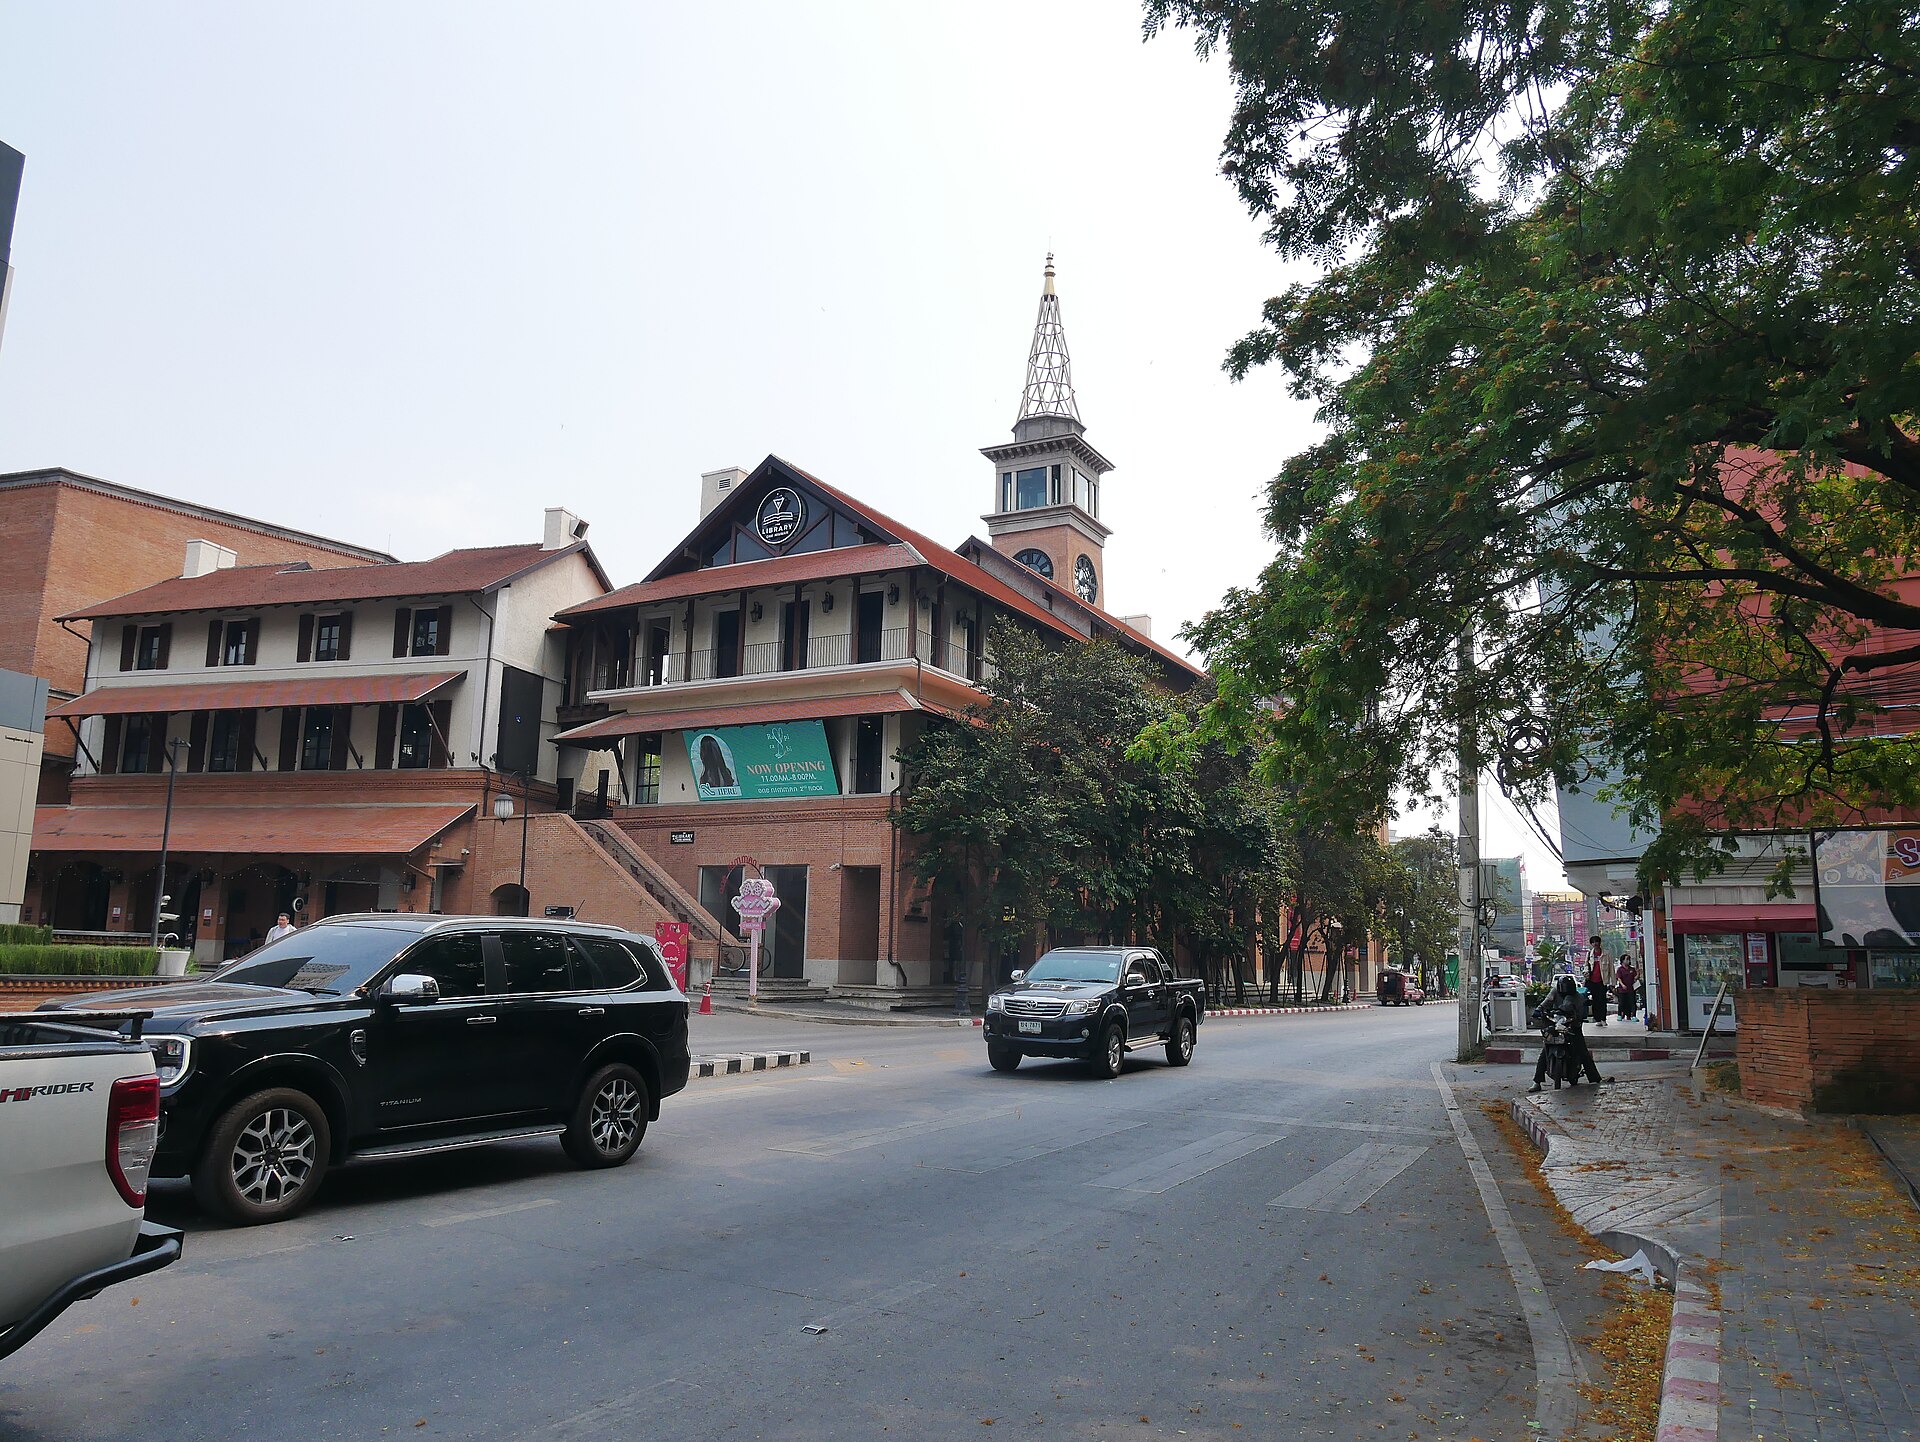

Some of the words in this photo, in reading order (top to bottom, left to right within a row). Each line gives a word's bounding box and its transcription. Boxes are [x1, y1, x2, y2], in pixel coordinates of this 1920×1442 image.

[761, 523, 793, 535] LIBRARY
[746, 763, 772, 775] NOW
[775, 760, 826, 775] OPENING
[380, 1098, 421, 1106] TITANIUM
